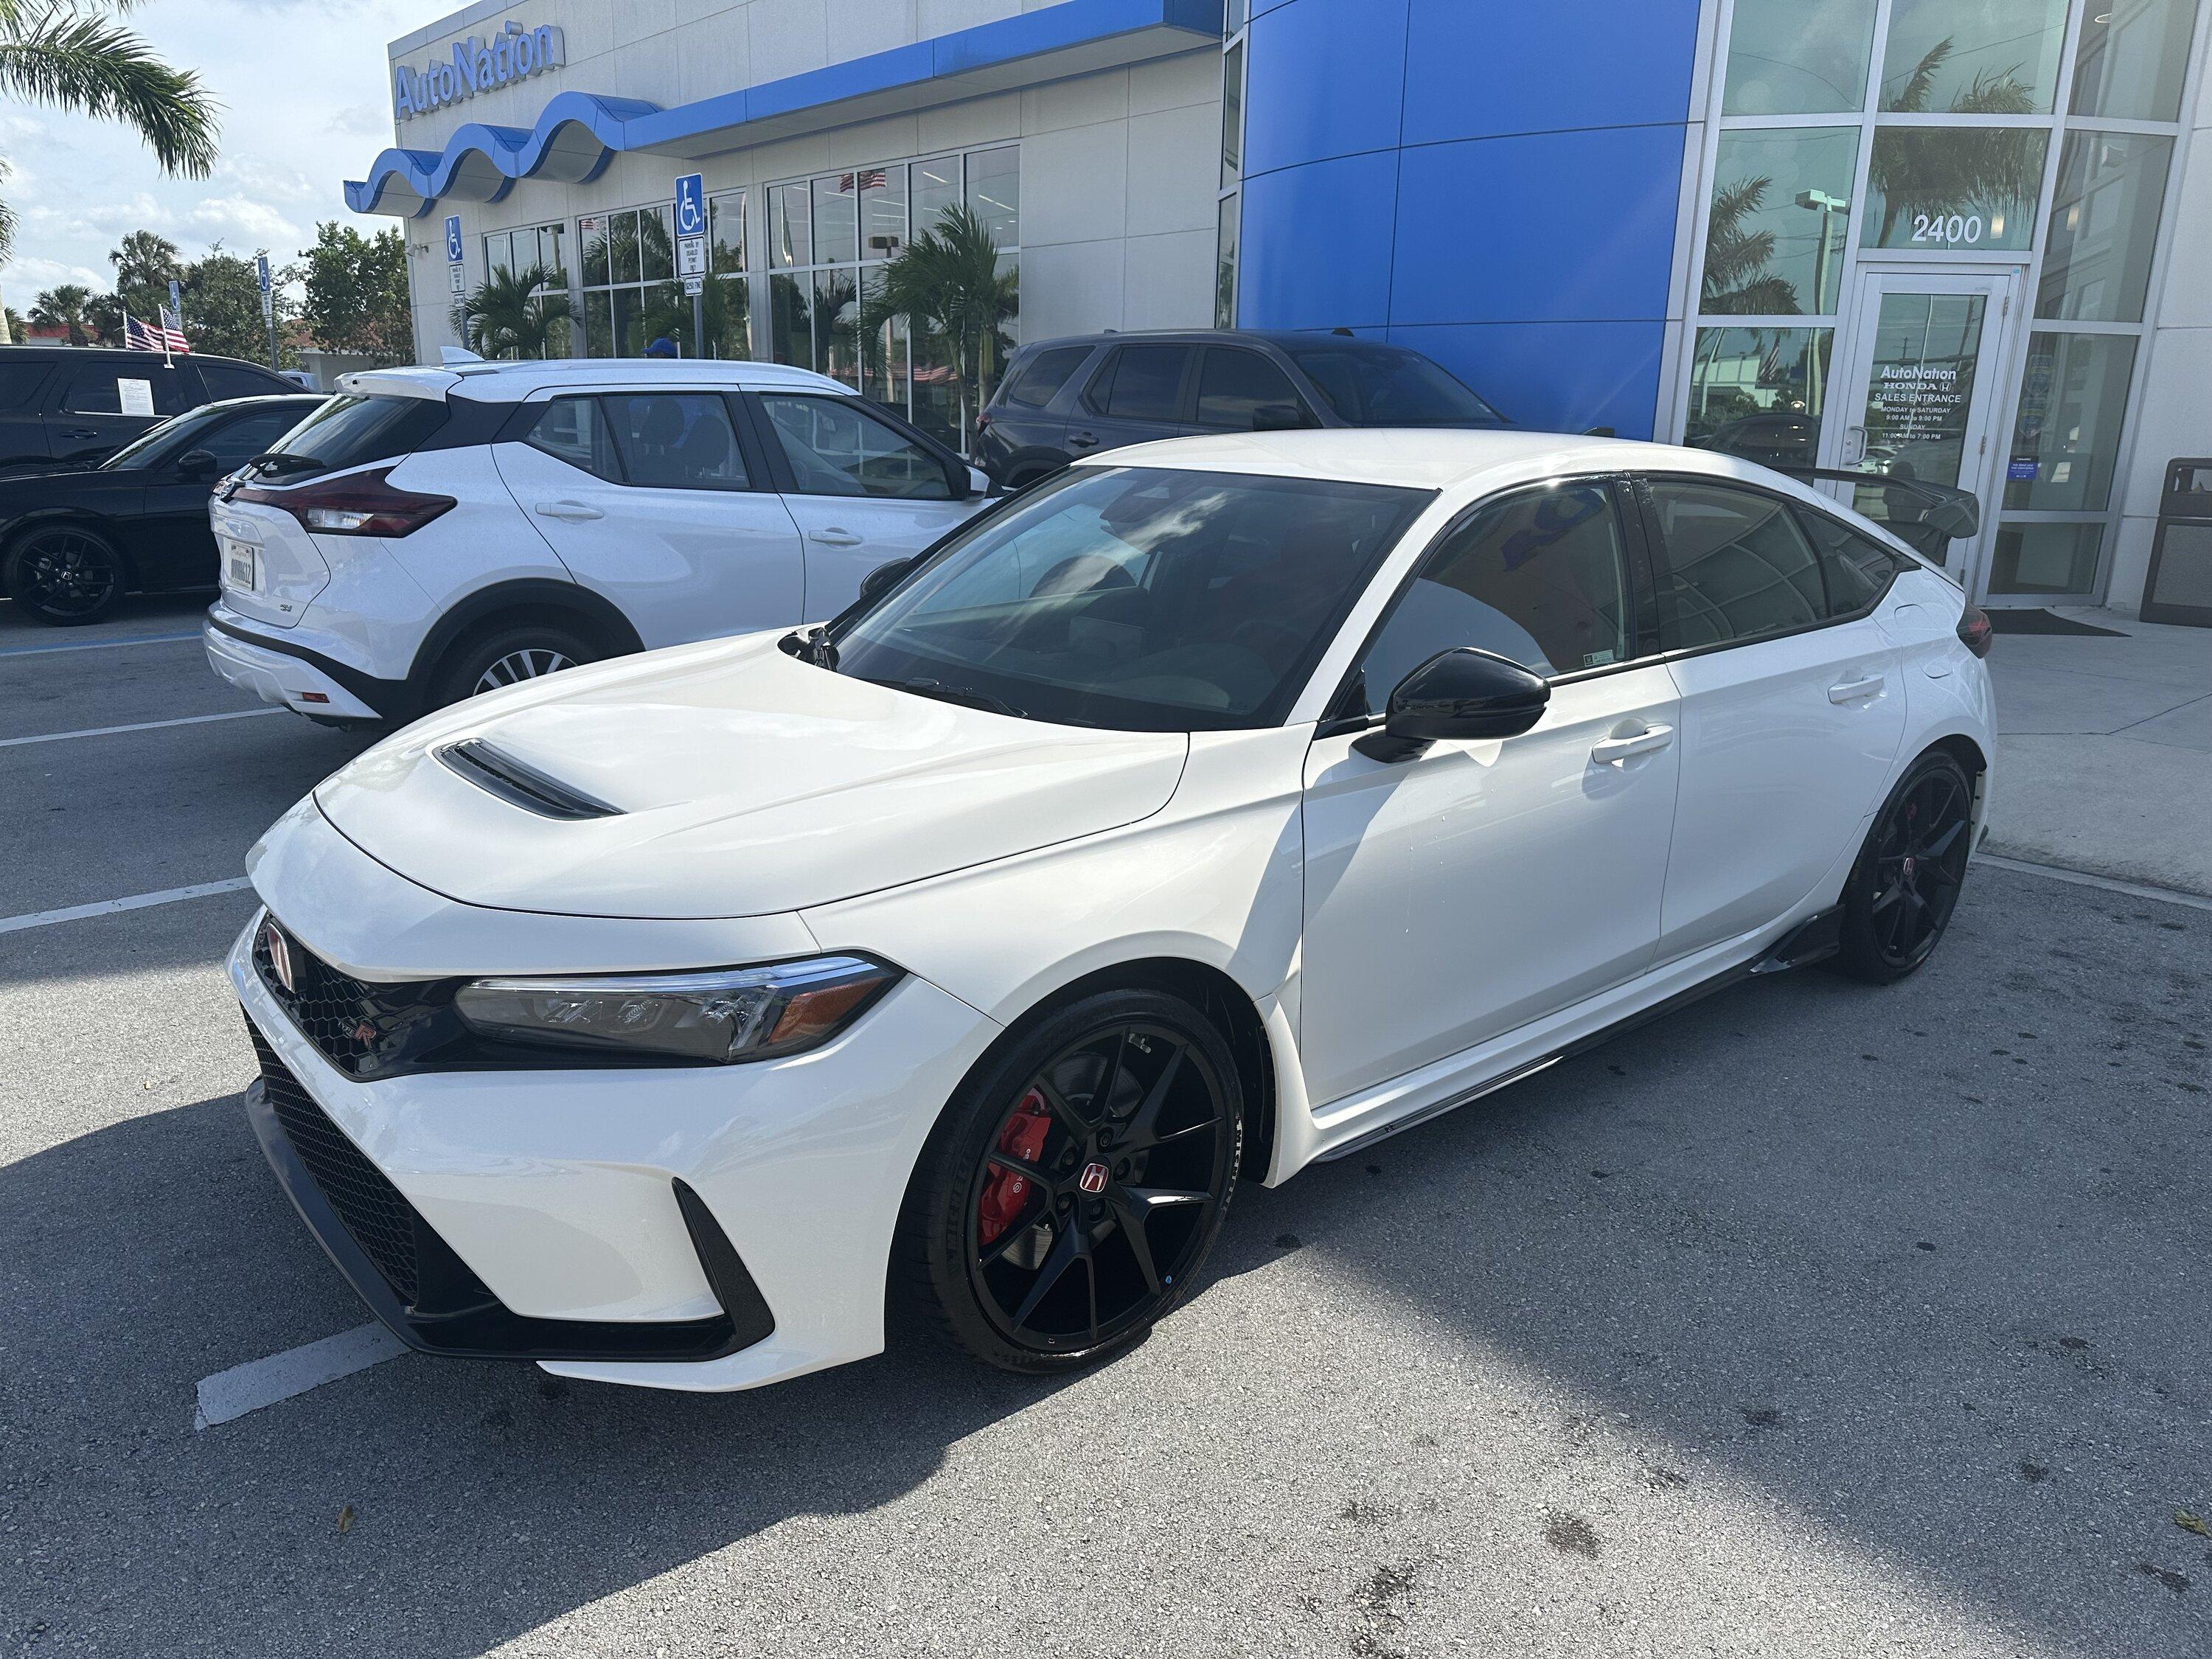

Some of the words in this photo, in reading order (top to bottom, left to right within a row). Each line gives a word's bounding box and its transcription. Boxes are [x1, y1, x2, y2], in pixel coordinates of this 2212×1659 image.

[395, 20, 557, 120] AutoNation
[1911, 214, 1982, 243] 2400
[1880, 365, 1957, 380] AutoNation
[1874, 393, 1907, 402] SALES
[1909, 394, 1961, 403] ENTRANCE
[1883, 382, 1938, 391] HONDA
[354, 1023, 377, 1049] R
[946, 1142, 976, 1251] MICHELI
